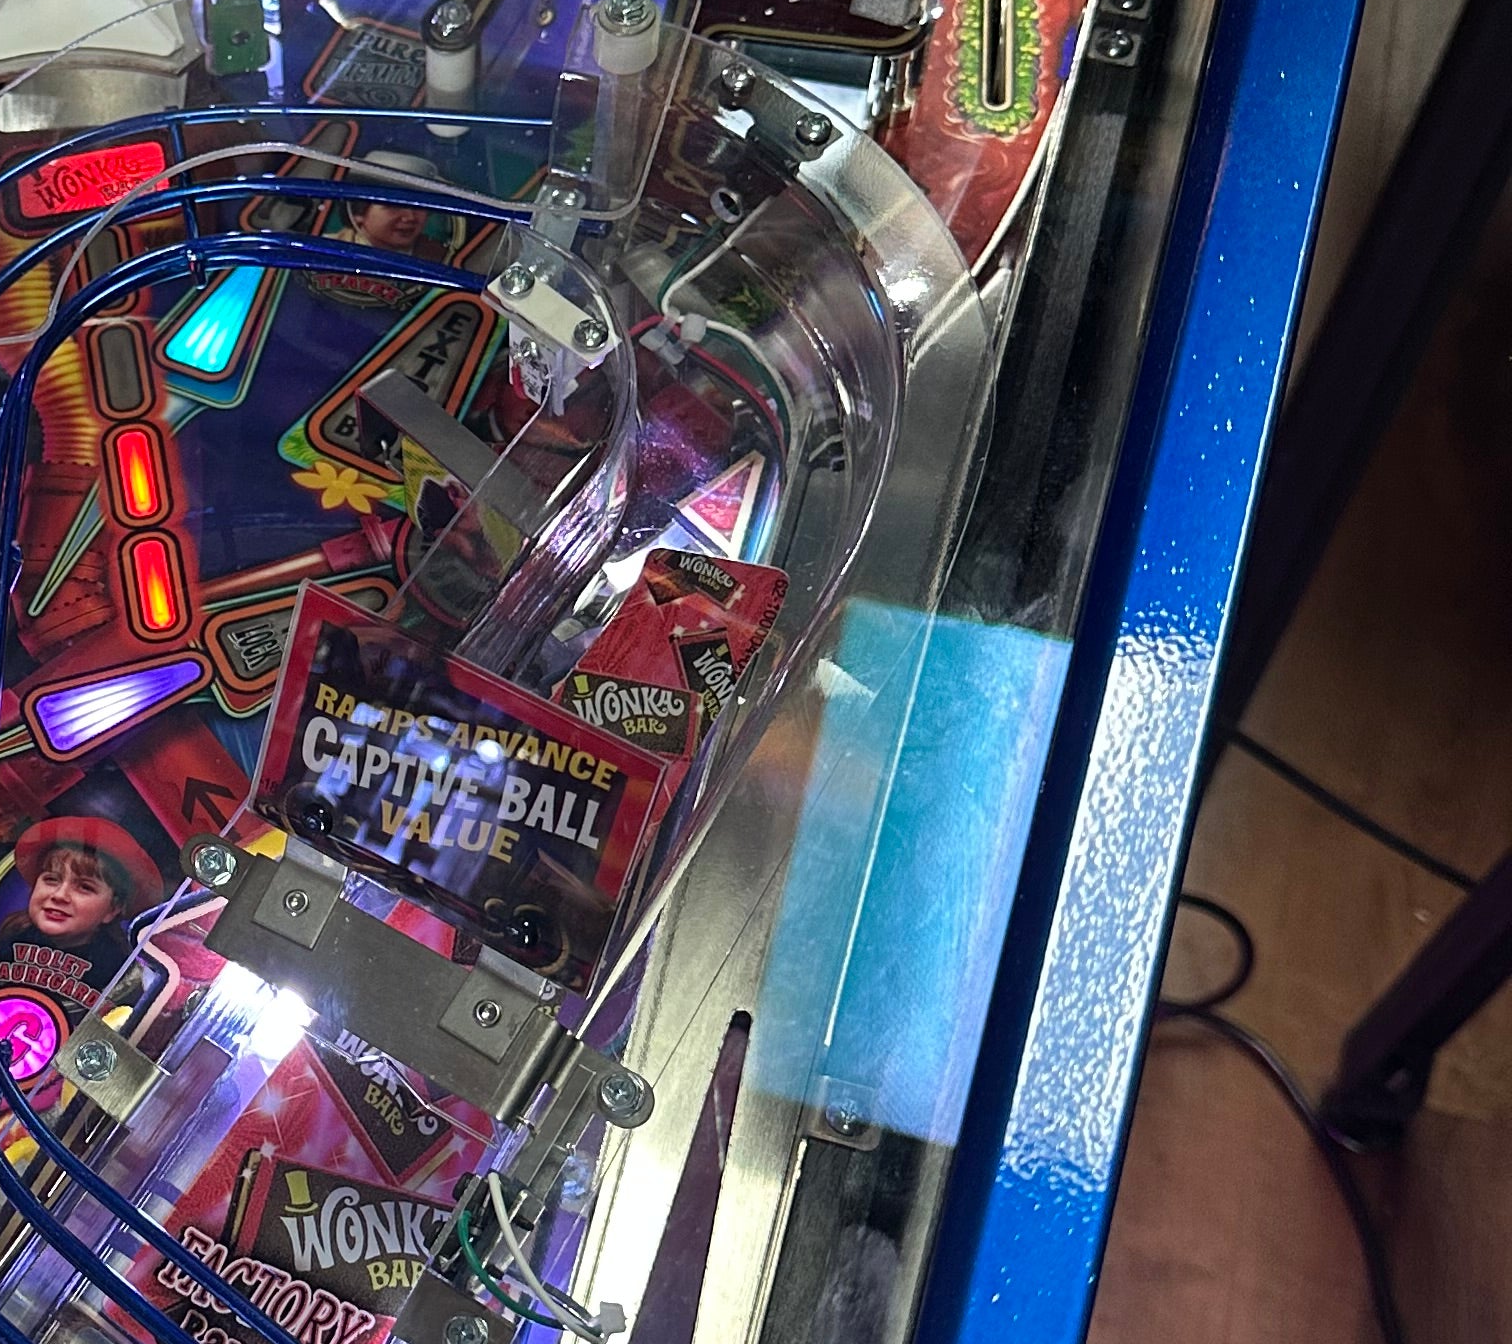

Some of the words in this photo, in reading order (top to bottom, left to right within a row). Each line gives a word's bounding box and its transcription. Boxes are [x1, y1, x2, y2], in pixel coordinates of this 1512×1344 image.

[35, 156, 148, 210] WONKA
[678, 554, 735, 588] WONKA
[227, 621, 285, 674] LOCK
[571, 680, 685, 727] WONKA
[622, 717, 668, 736] BAR
[447, 721, 619, 792] ADVANCE
[301, 716, 487, 813] CAPTIVE
[497, 774, 601, 851] BALL
[380, 798, 521, 864] VALUE
[13, 942, 93, 980] VIOLET
[363, 1082, 405, 1136] BAR
